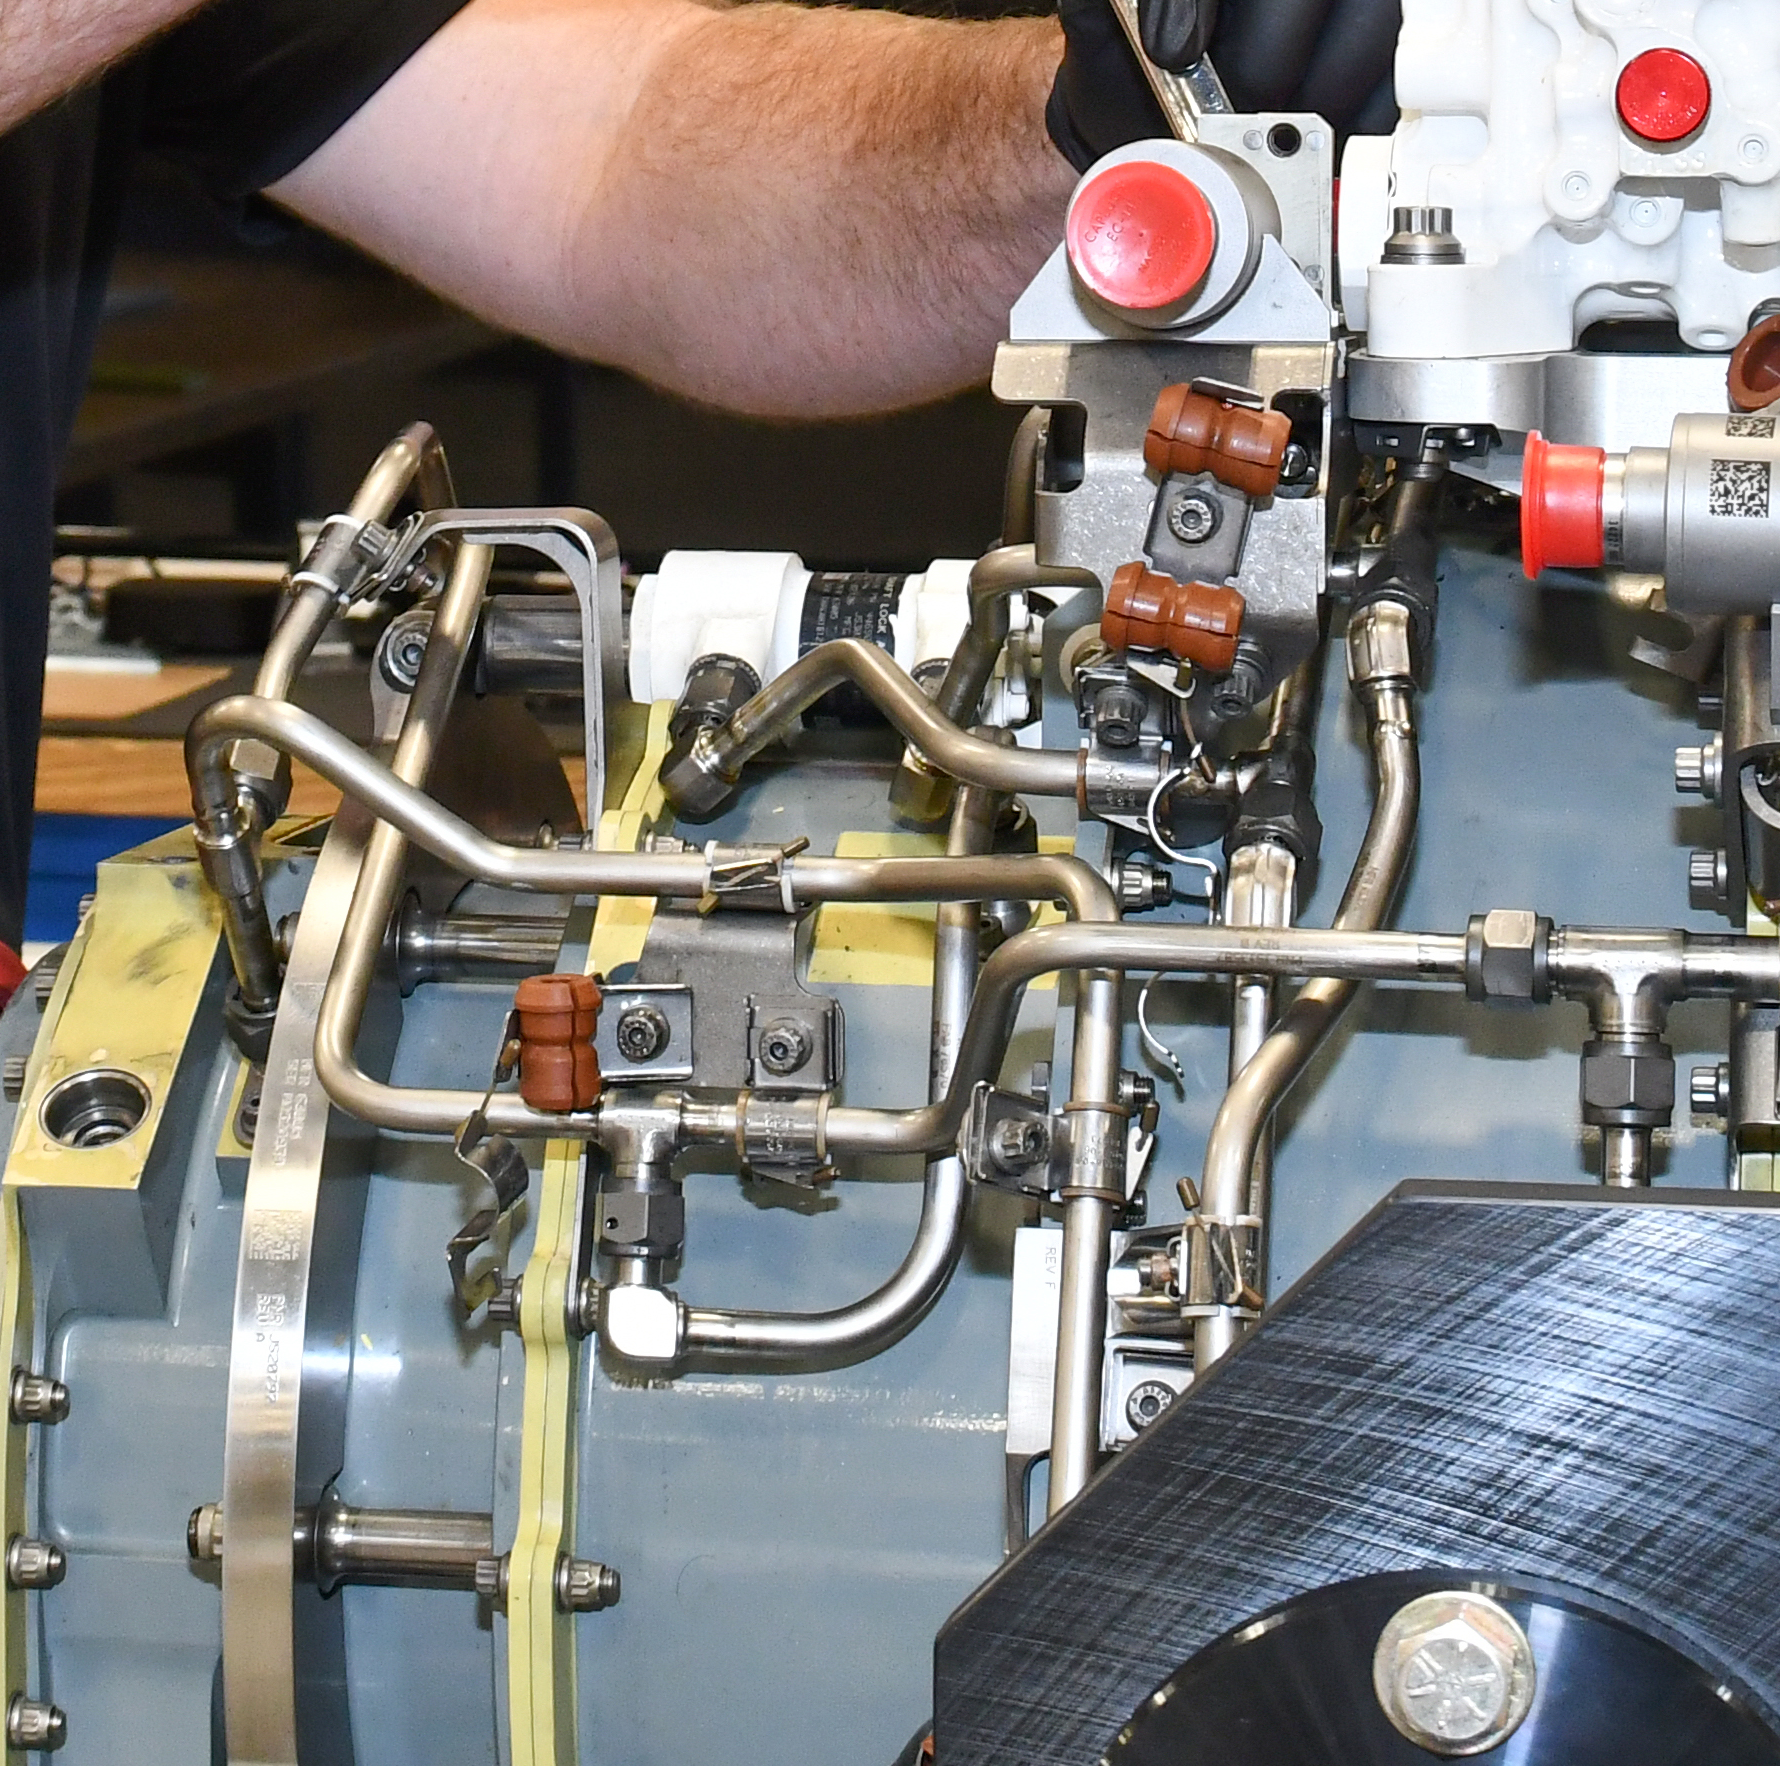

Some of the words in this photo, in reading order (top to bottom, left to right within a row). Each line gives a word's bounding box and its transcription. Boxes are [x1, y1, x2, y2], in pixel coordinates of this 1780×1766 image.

[876, 602, 890, 634] LOCK
[1044, 1246, 1057, 1275] REV
[1044, 1281, 1056, 1290] F
